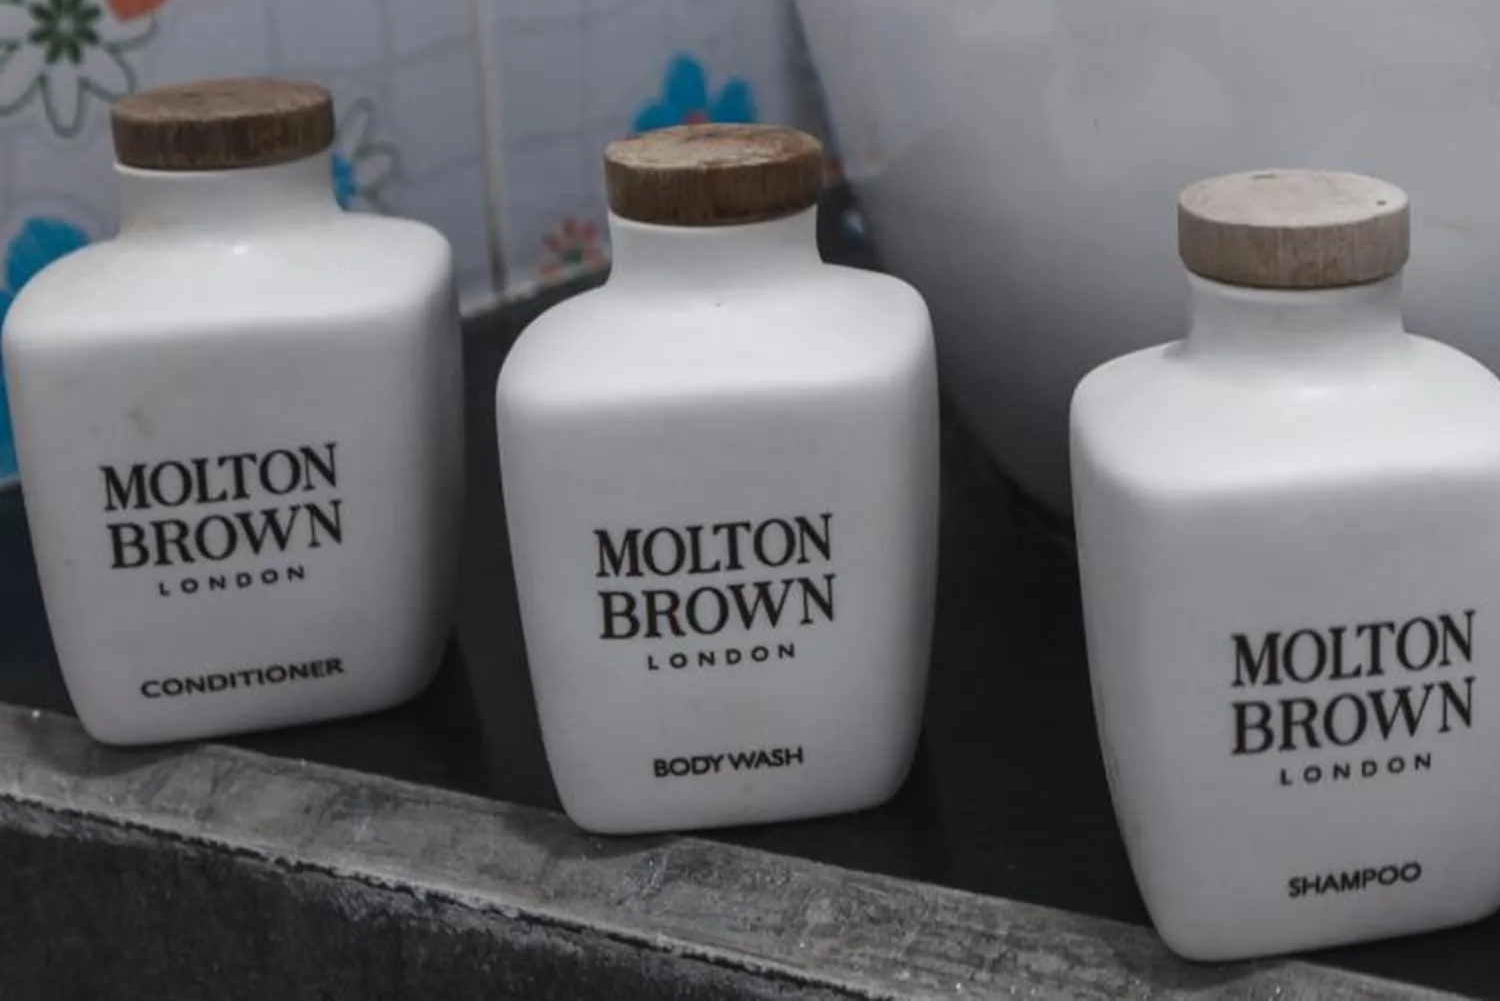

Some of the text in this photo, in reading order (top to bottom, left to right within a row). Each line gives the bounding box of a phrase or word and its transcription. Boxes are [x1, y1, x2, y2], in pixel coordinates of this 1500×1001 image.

[99, 441, 337, 512] MOLTON
[106, 498, 343, 570] BROWN
[592, 512, 833, 578] MOLTON
[158, 565, 305, 597] LONDON
[597, 572, 837, 640] BROWN
[647, 642, 795, 671] LONDON
[1230, 608, 1476, 688] MOLTON
[139, 657, 345, 699] CONDITIONER
[1231, 675, 1476, 756] BROWN
[652, 746, 804, 779] BODY WASH
[1279, 752, 1432, 787] LONDON
[1287, 861, 1423, 899] SHAMPOO
